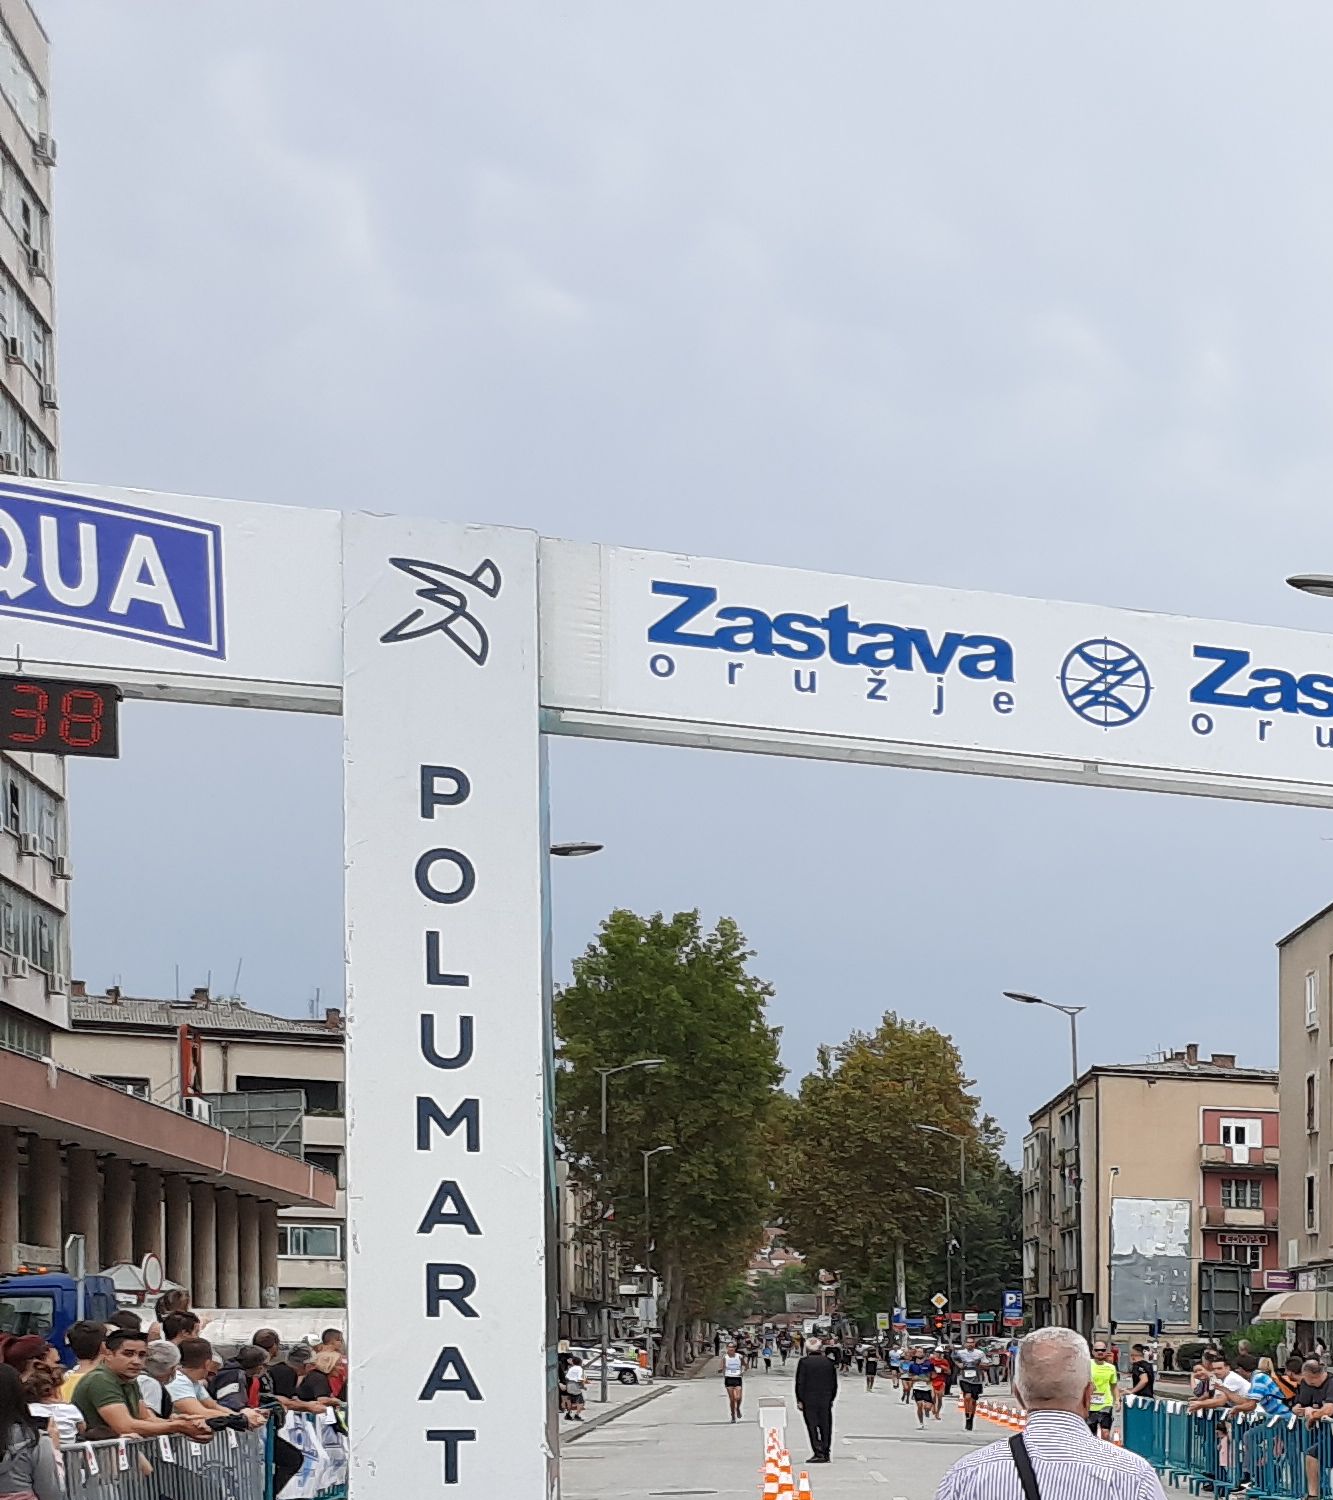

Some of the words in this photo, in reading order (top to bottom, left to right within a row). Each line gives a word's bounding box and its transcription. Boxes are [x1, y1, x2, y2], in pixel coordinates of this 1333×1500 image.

[647, 580, 1015, 683] Zastava
[9, 684, 104, 747] 38
[649, 653, 1016, 715] oružje
